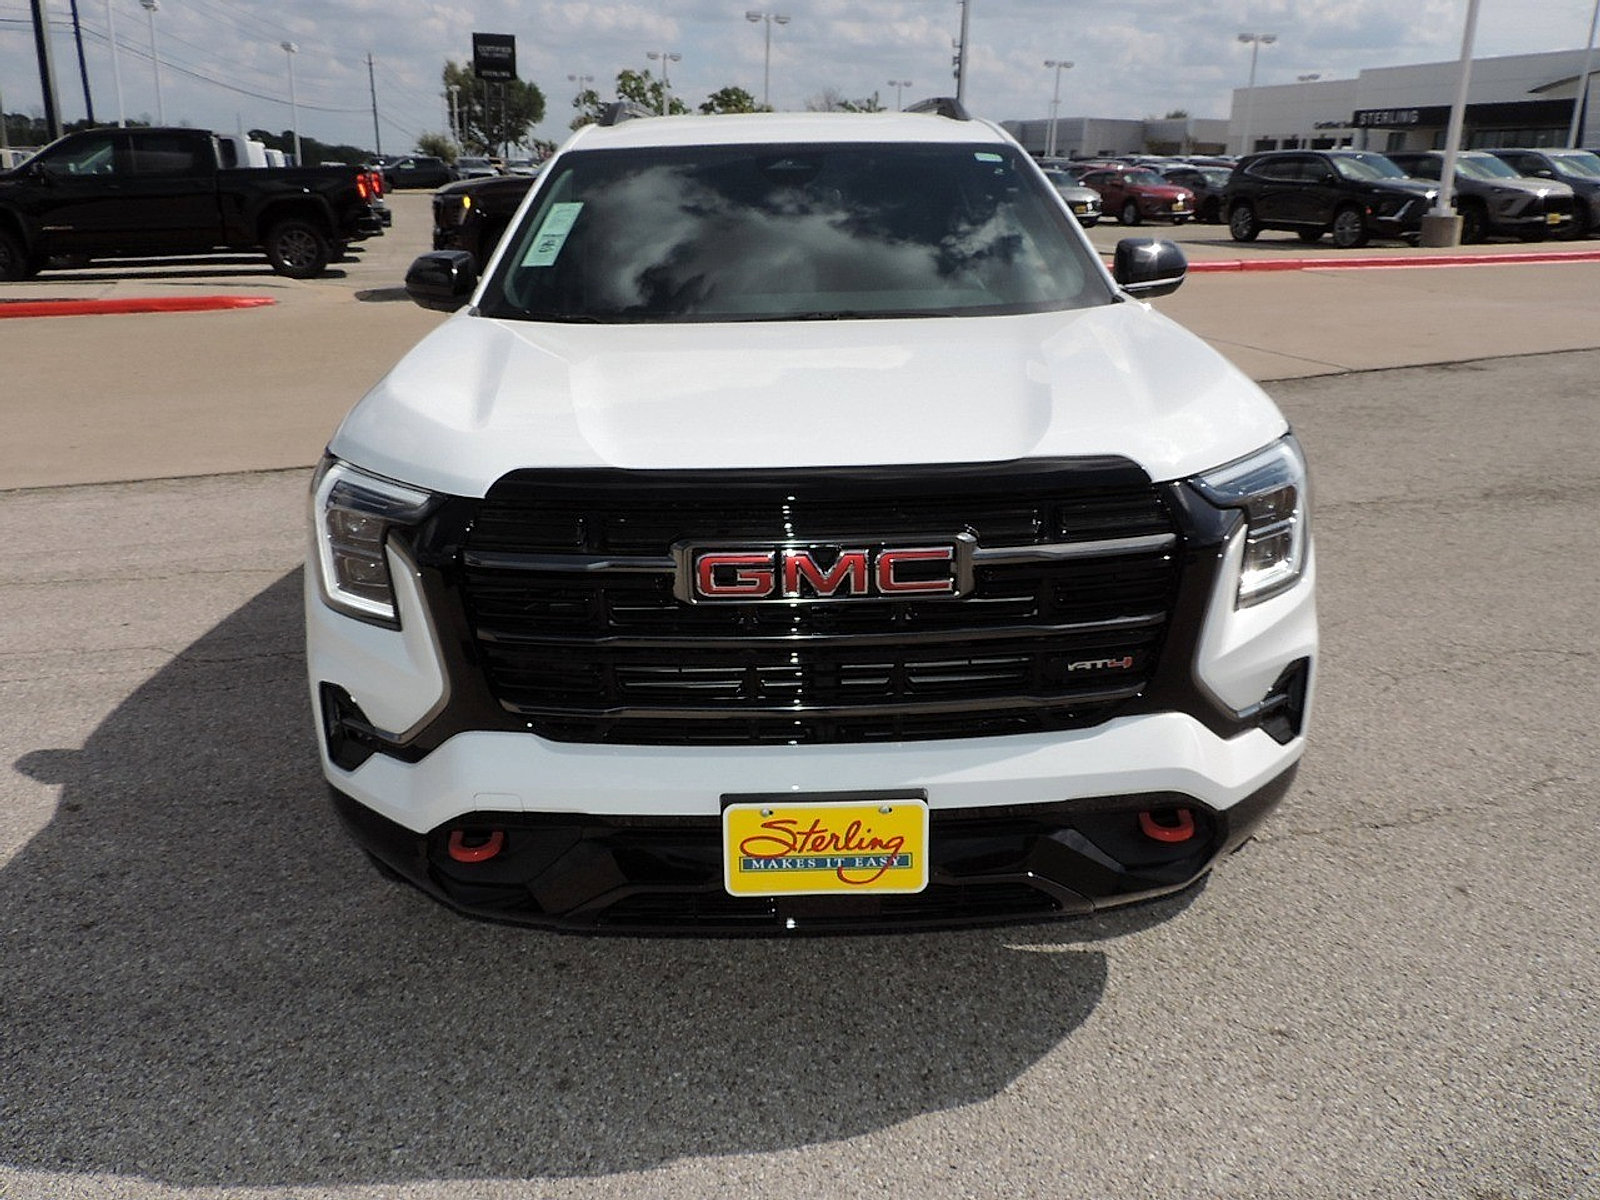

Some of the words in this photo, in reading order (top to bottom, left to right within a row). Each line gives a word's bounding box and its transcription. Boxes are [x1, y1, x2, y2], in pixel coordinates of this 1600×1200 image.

[1359, 110, 1419, 125] STERLING
[696, 548, 955, 597] GMC
[1067, 656, 1133, 671] AT4
[739, 818, 905, 885] Sterling
[751, 857, 817, 870] MAKES
[826, 857, 844, 868] IT
[854, 855, 900, 868] EASY
